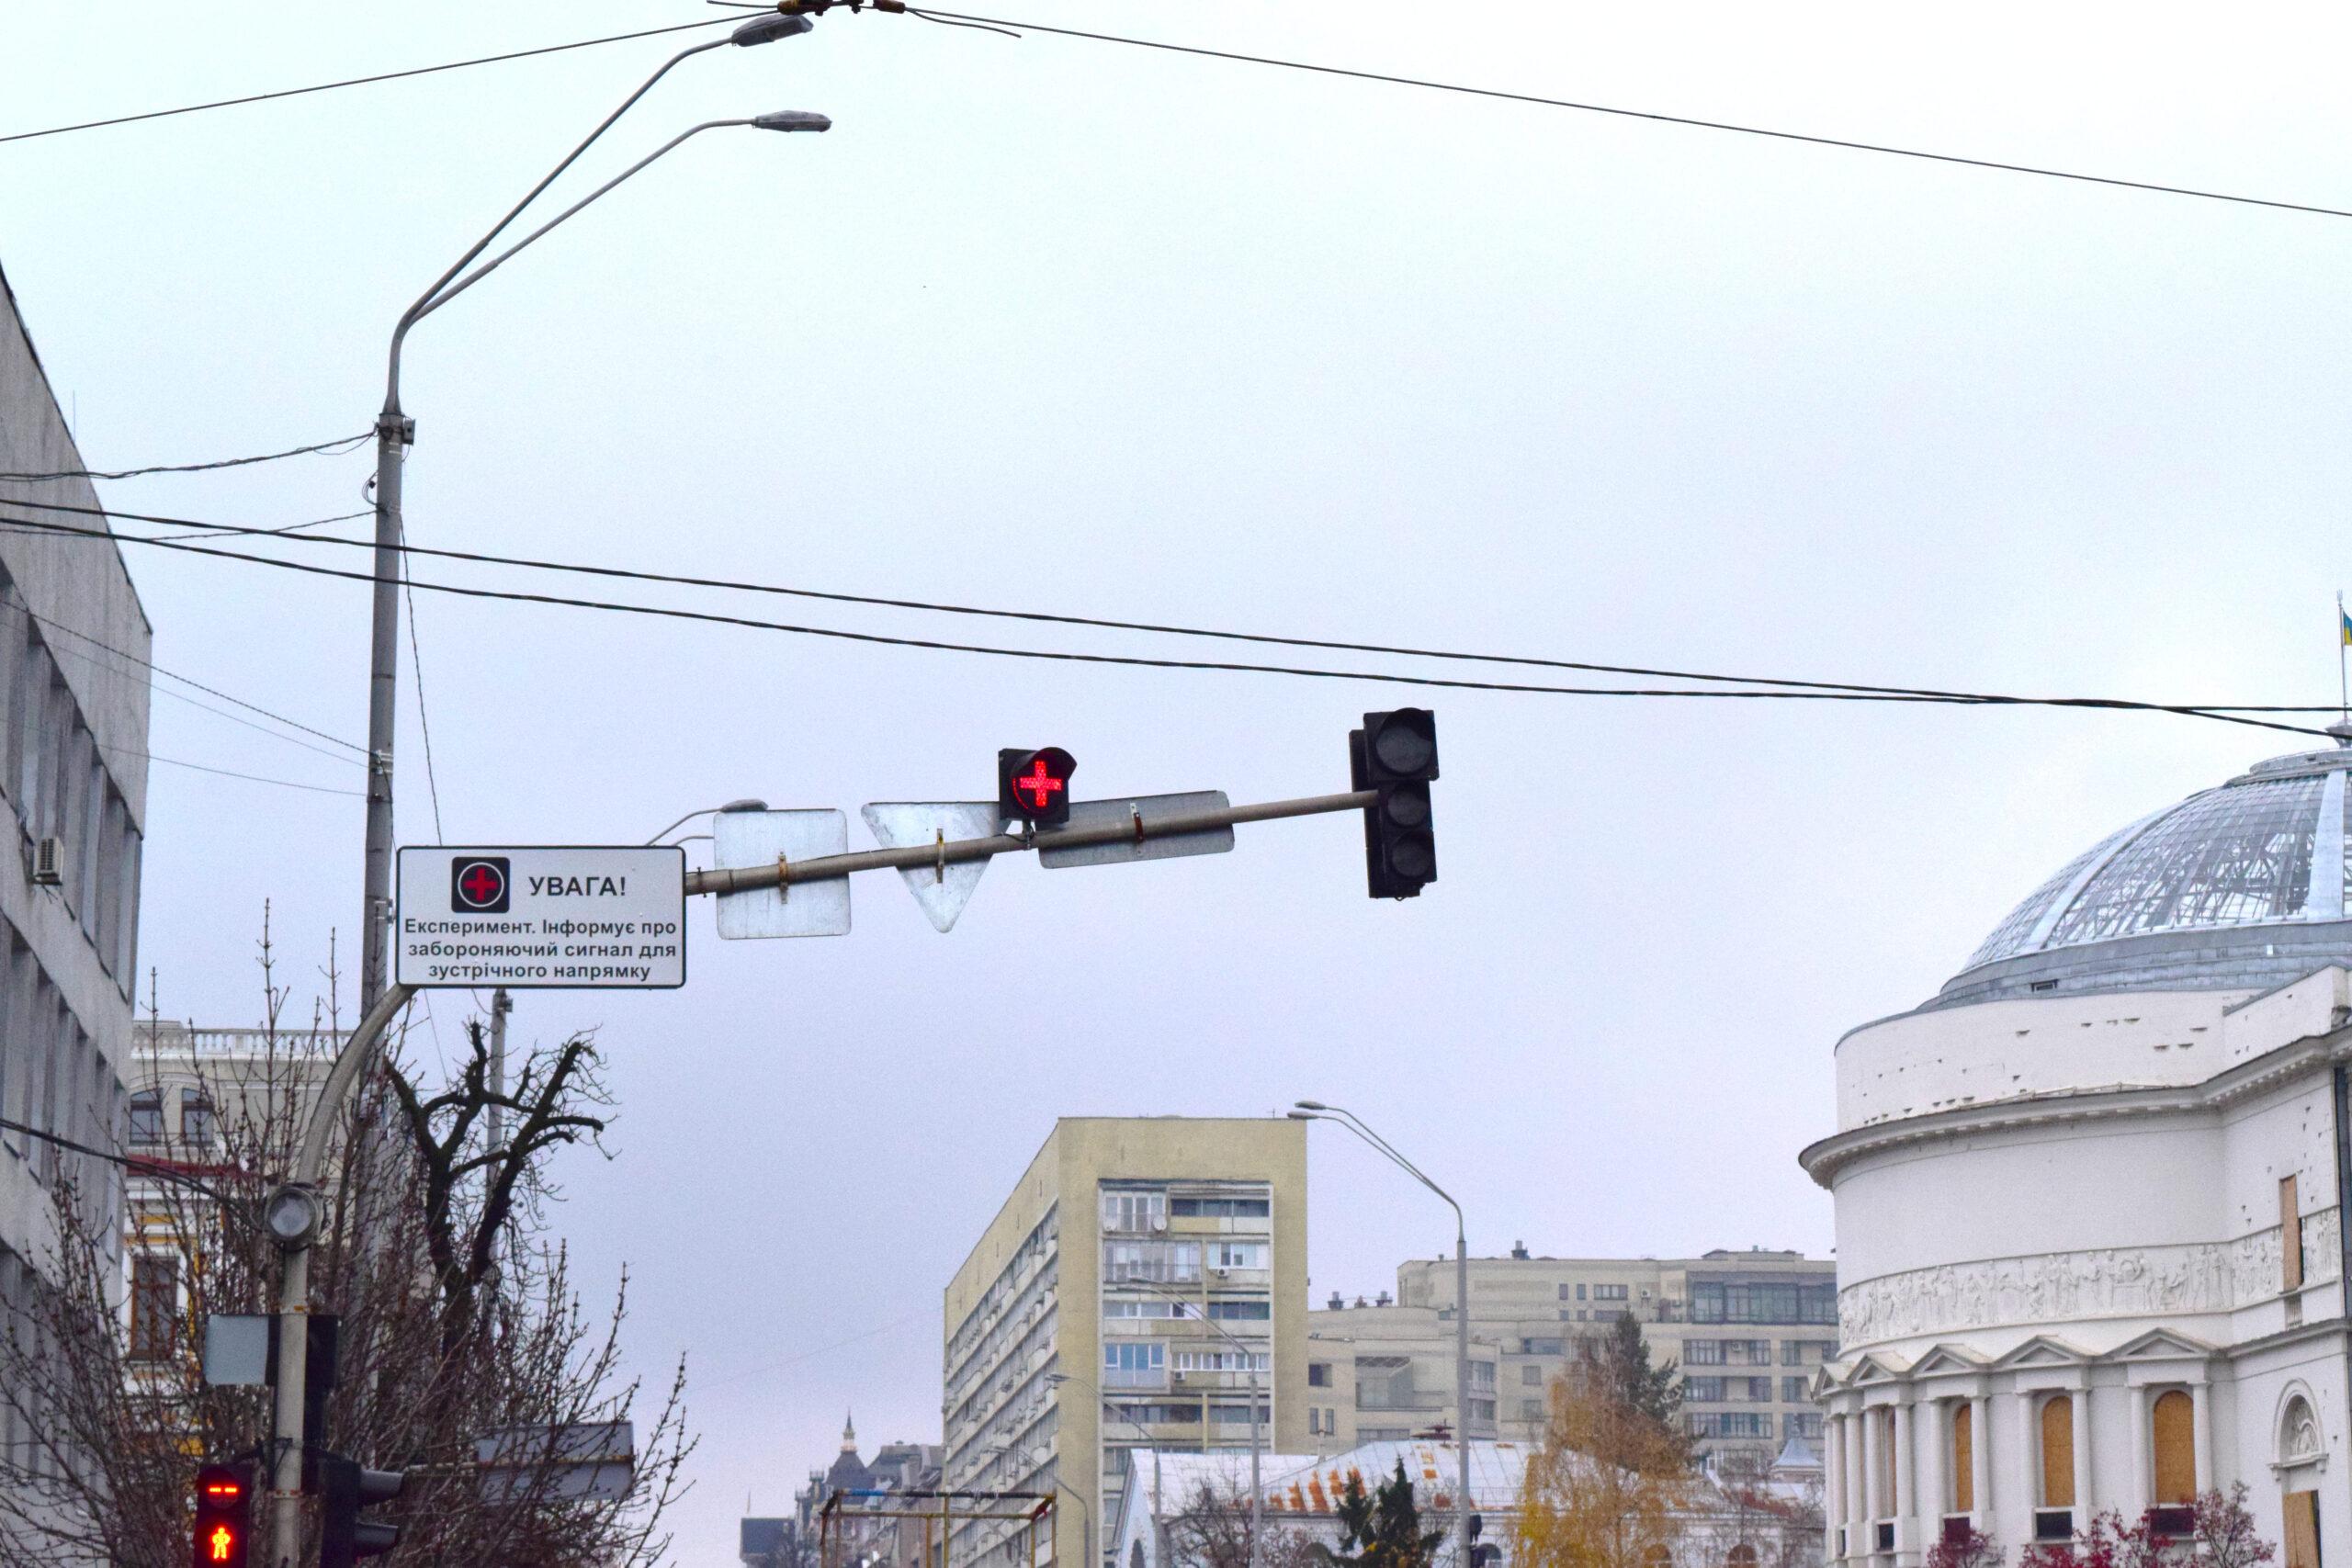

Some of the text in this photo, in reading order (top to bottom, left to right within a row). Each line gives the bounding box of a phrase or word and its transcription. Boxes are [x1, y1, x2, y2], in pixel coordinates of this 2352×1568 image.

[528, 876, 626, 896] УВАГА!
[404, 919, 676, 938] Експеримент. Інформує про
[408, 942, 676, 960] забороняючий сигнал для
[428, 963, 651, 982] зустрічного напрямку
